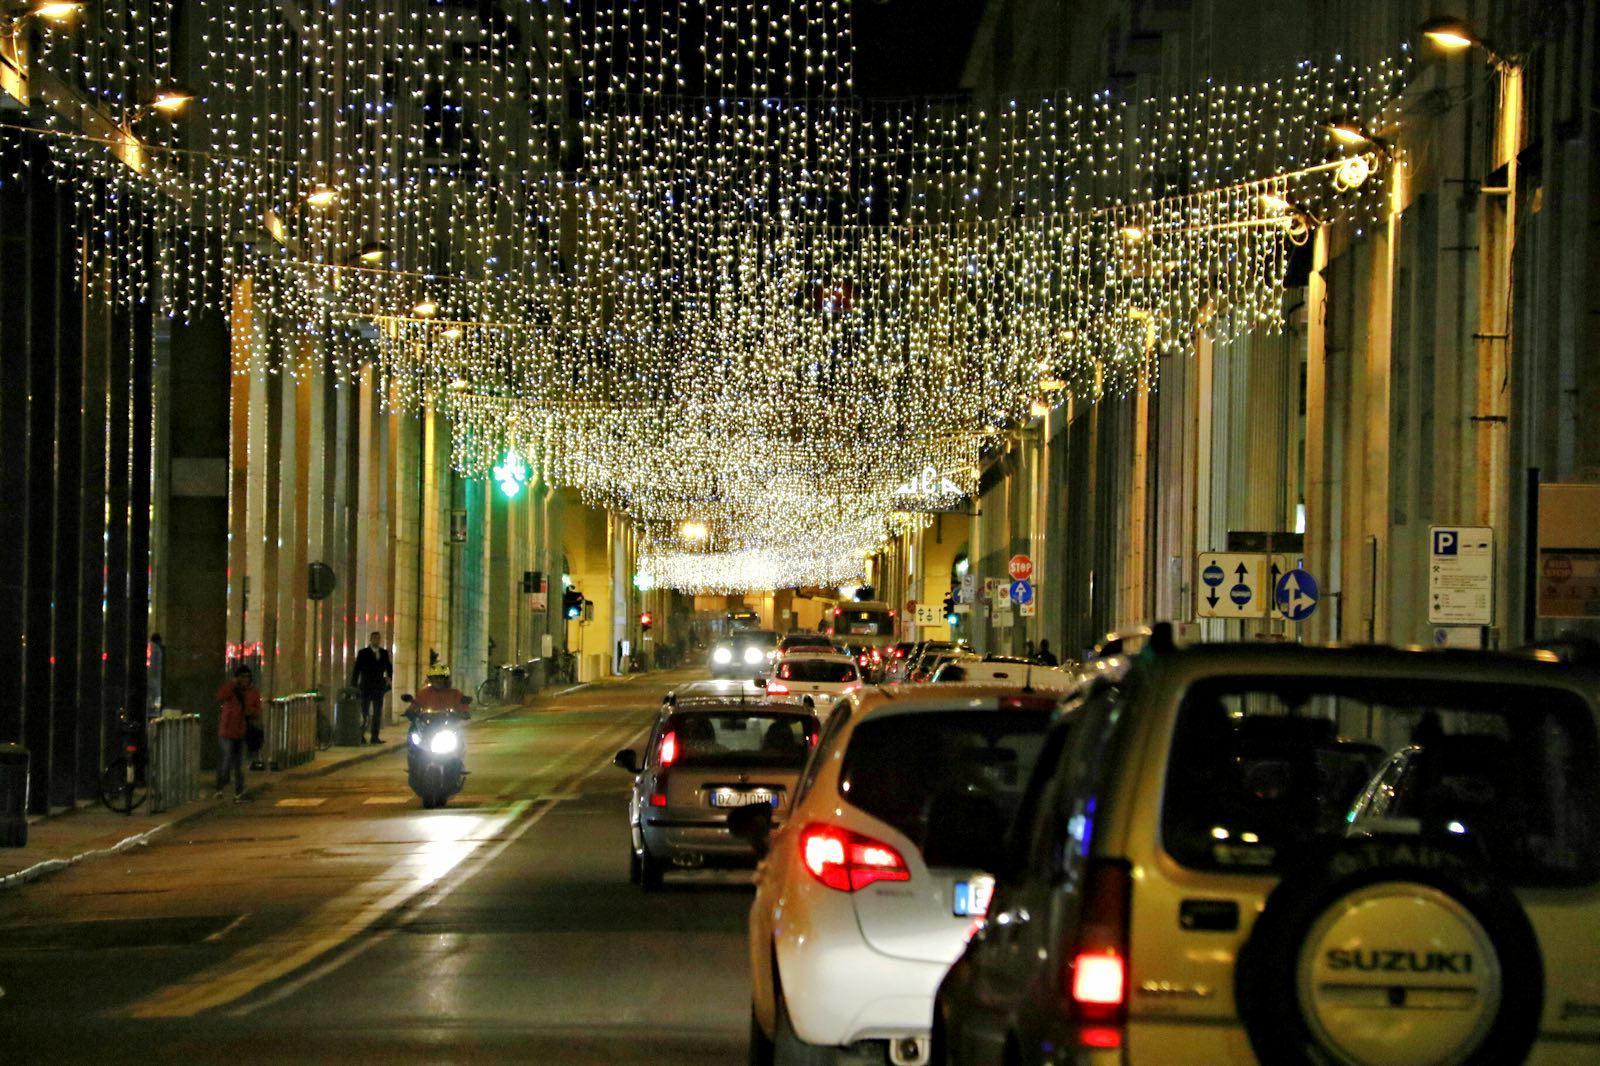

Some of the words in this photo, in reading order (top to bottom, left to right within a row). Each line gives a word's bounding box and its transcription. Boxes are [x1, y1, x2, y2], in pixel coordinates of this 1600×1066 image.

[1438, 533, 1453, 553] P
[1010, 562, 1032, 573] STOP
[718, 793, 732, 805] DZ
[1326, 949, 1473, 973] SUZUKI
